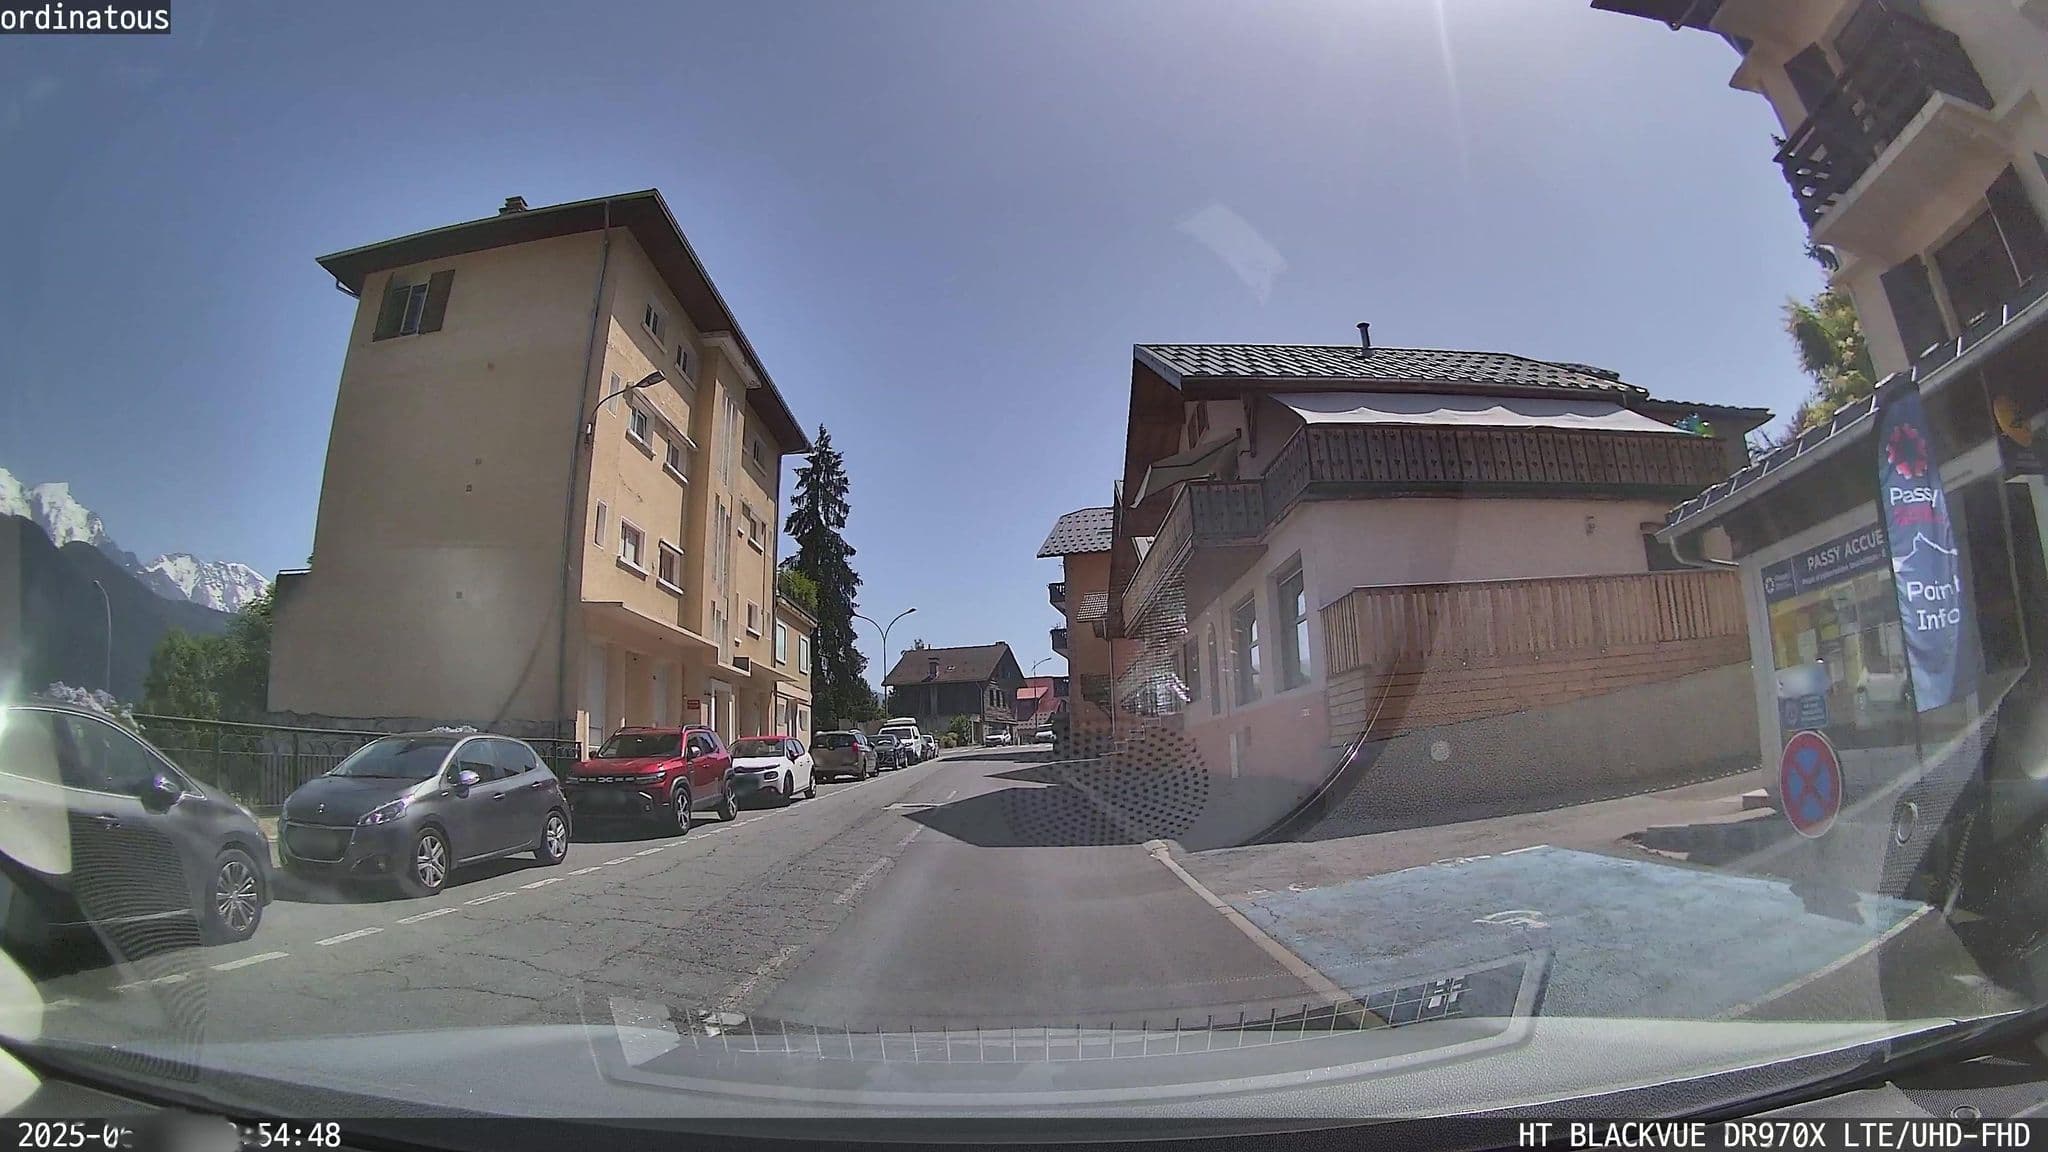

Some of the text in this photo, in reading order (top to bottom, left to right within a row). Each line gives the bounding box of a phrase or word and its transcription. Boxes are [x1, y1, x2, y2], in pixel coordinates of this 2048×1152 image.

[1889, 487, 1938, 508] Passy
[1807, 546, 1841, 572] PASSY
[1906, 574, 1961, 602] Point
[1916, 607, 1961, 632] Info
